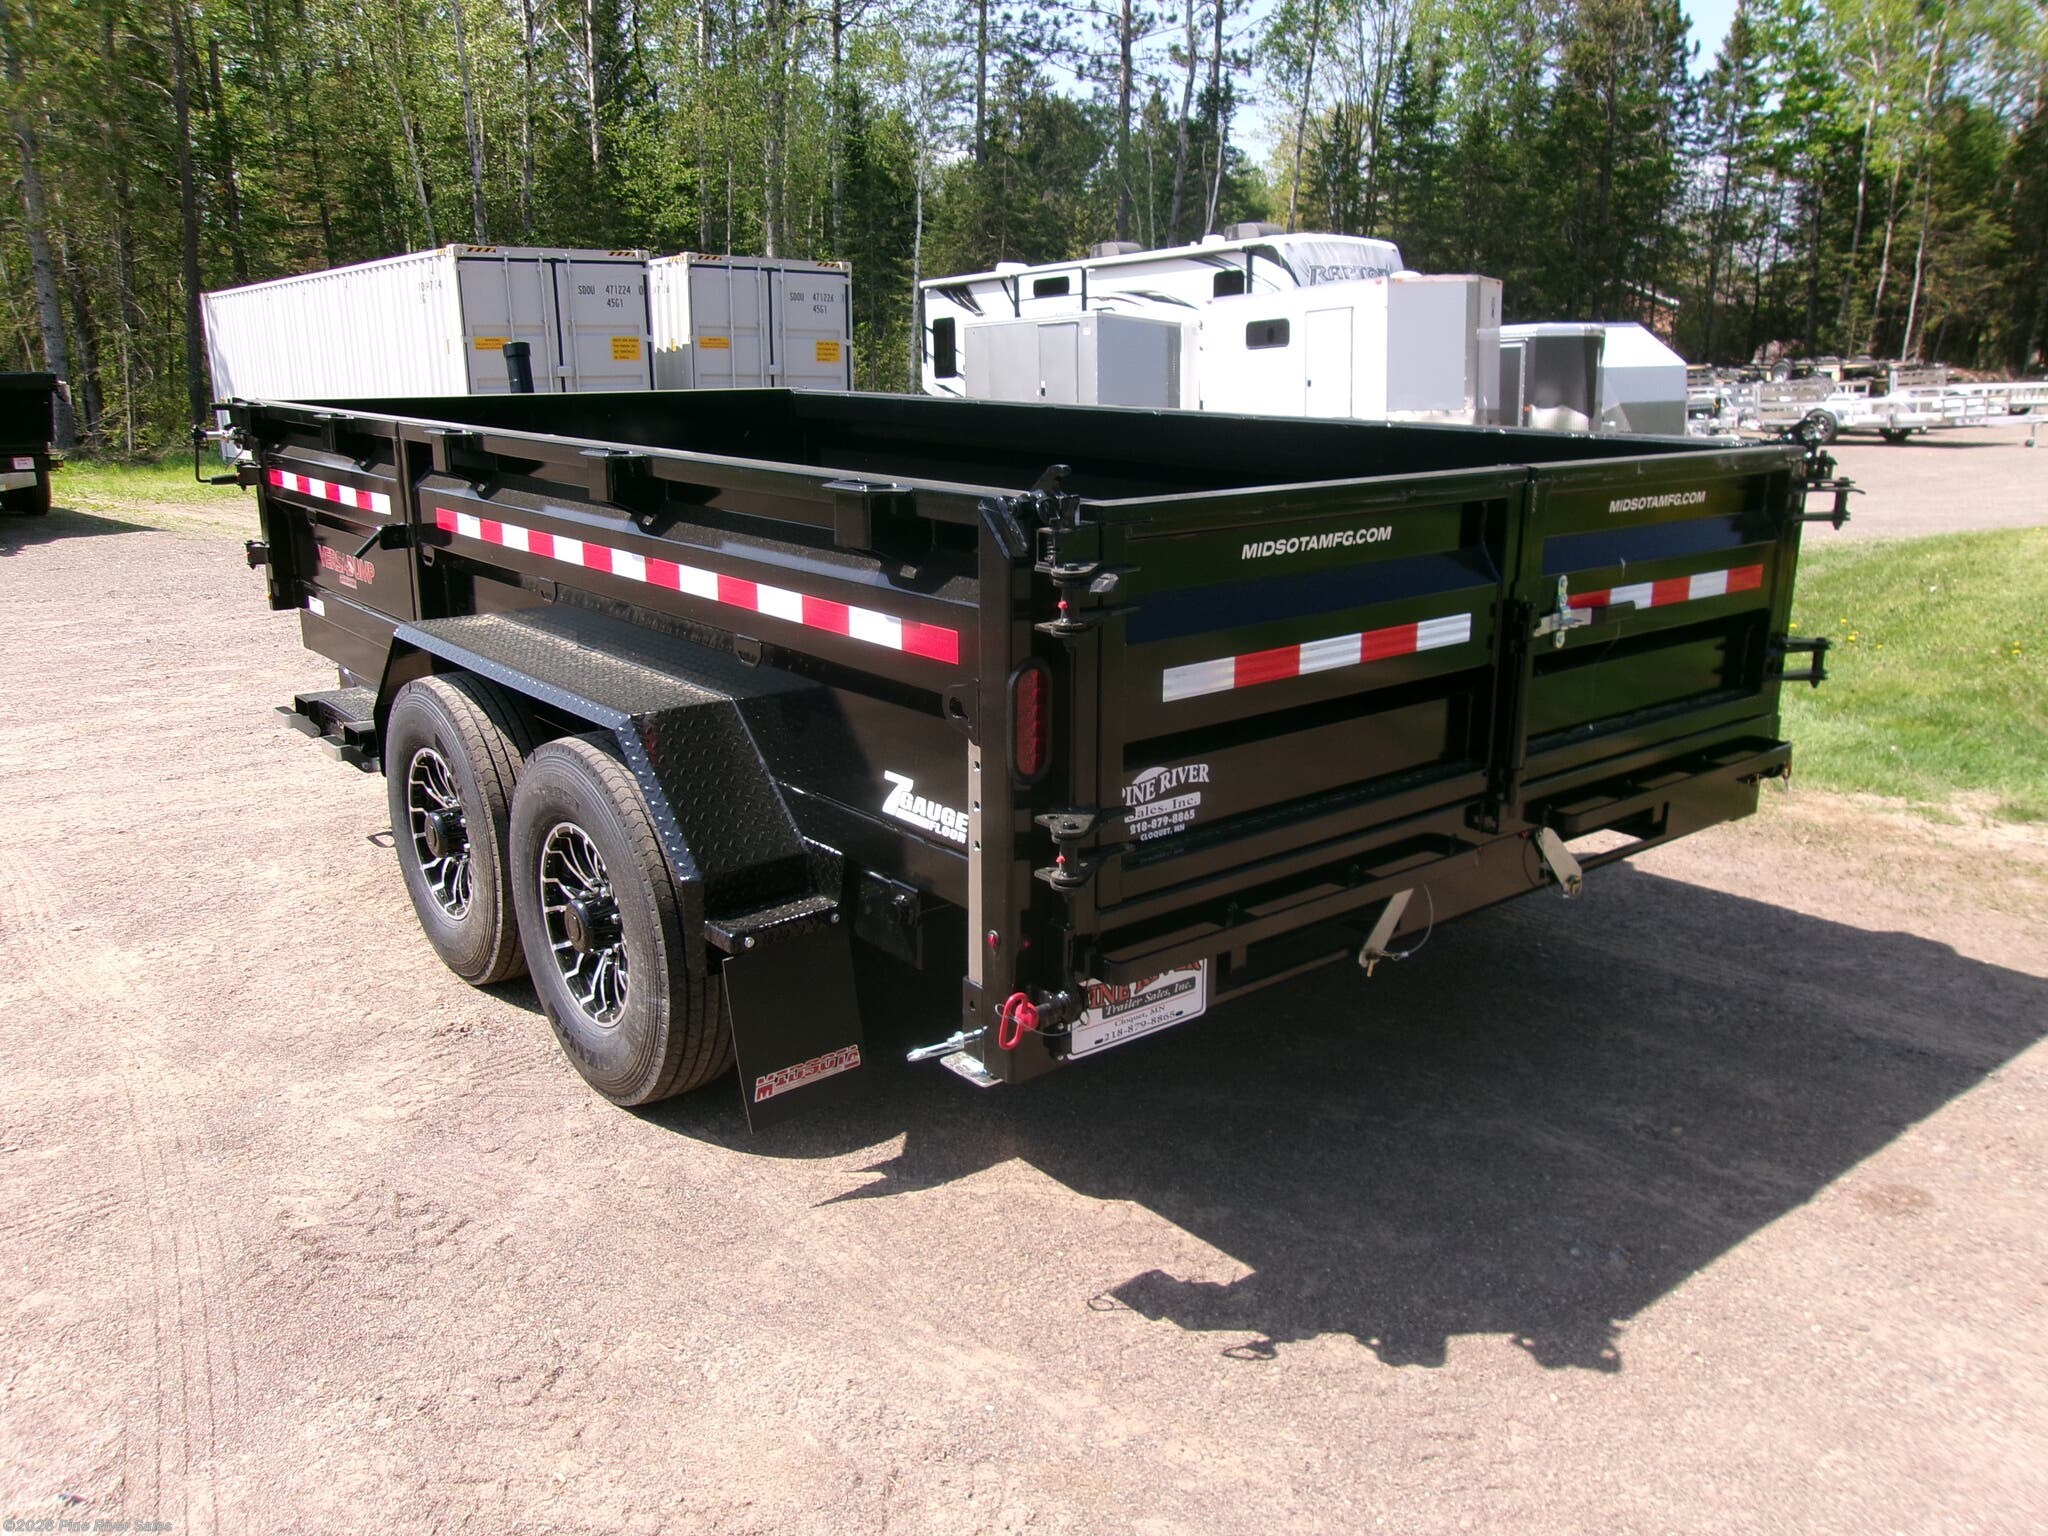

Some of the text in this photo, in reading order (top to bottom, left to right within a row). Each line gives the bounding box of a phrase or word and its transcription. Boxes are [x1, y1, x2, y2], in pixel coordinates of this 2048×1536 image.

[1609, 491, 1706, 513] MIDSOTAMFG.COM
[1241, 526, 1392, 560] MIDSOTAMFG.COM
[1159, 764, 1210, 794] RIVER
[882, 770, 969, 833] 7 GAUGE
[929, 820, 967, 844] FLOOR
[1129, 809, 1196, 835] 218-879-8865
[1140, 827, 1174, 842] CLOQUET,
[1088, 981, 1131, 1009] INE
[1105, 980, 1193, 1016] Trailer Sales, Inc.
[1104, 1010, 1176, 1041] 218-879-8865
[755, 1044, 861, 1103] MIDSOTA
